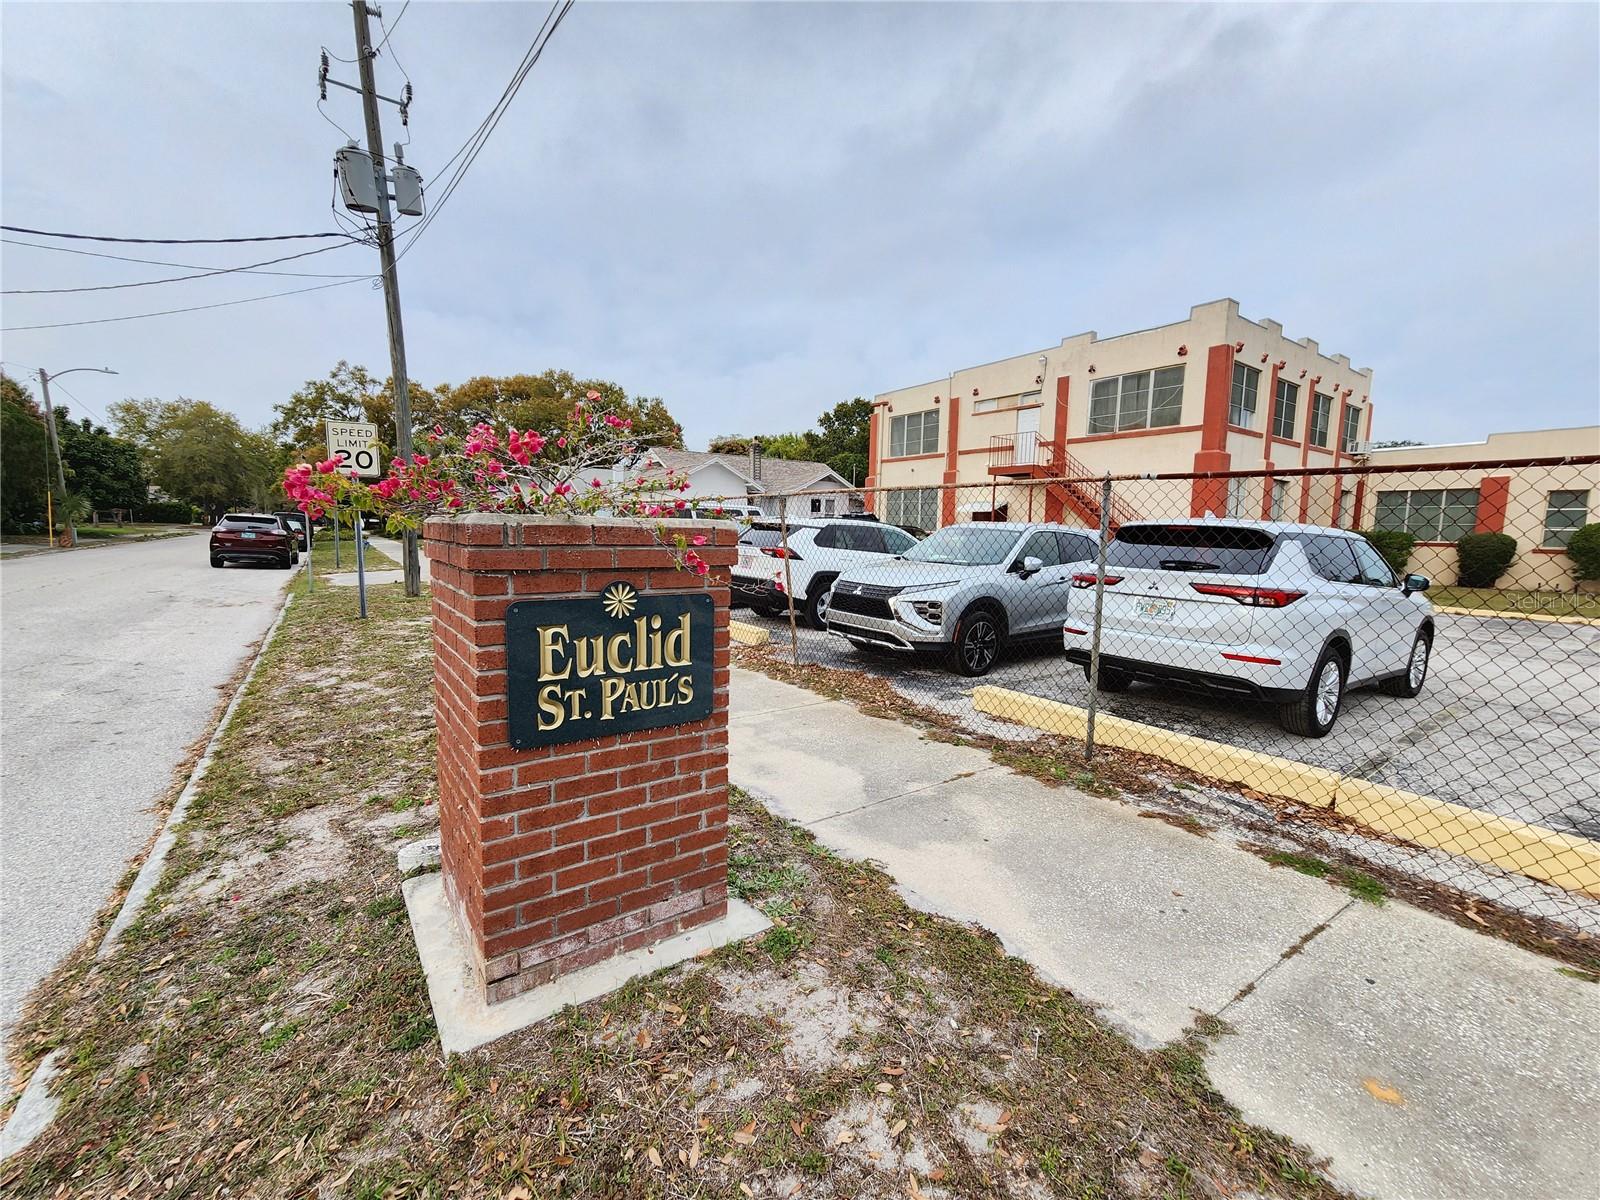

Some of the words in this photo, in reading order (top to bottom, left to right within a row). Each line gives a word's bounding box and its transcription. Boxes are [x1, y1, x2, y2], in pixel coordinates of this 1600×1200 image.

[331, 427, 373, 438] SPEED
[337, 439, 368, 448] LIMIT
[334, 450, 373, 469] 20
[536, 612, 692, 682] Euclid
[537, 682, 592, 731] ST.
[600, 672, 694, 721] PAUL'S
